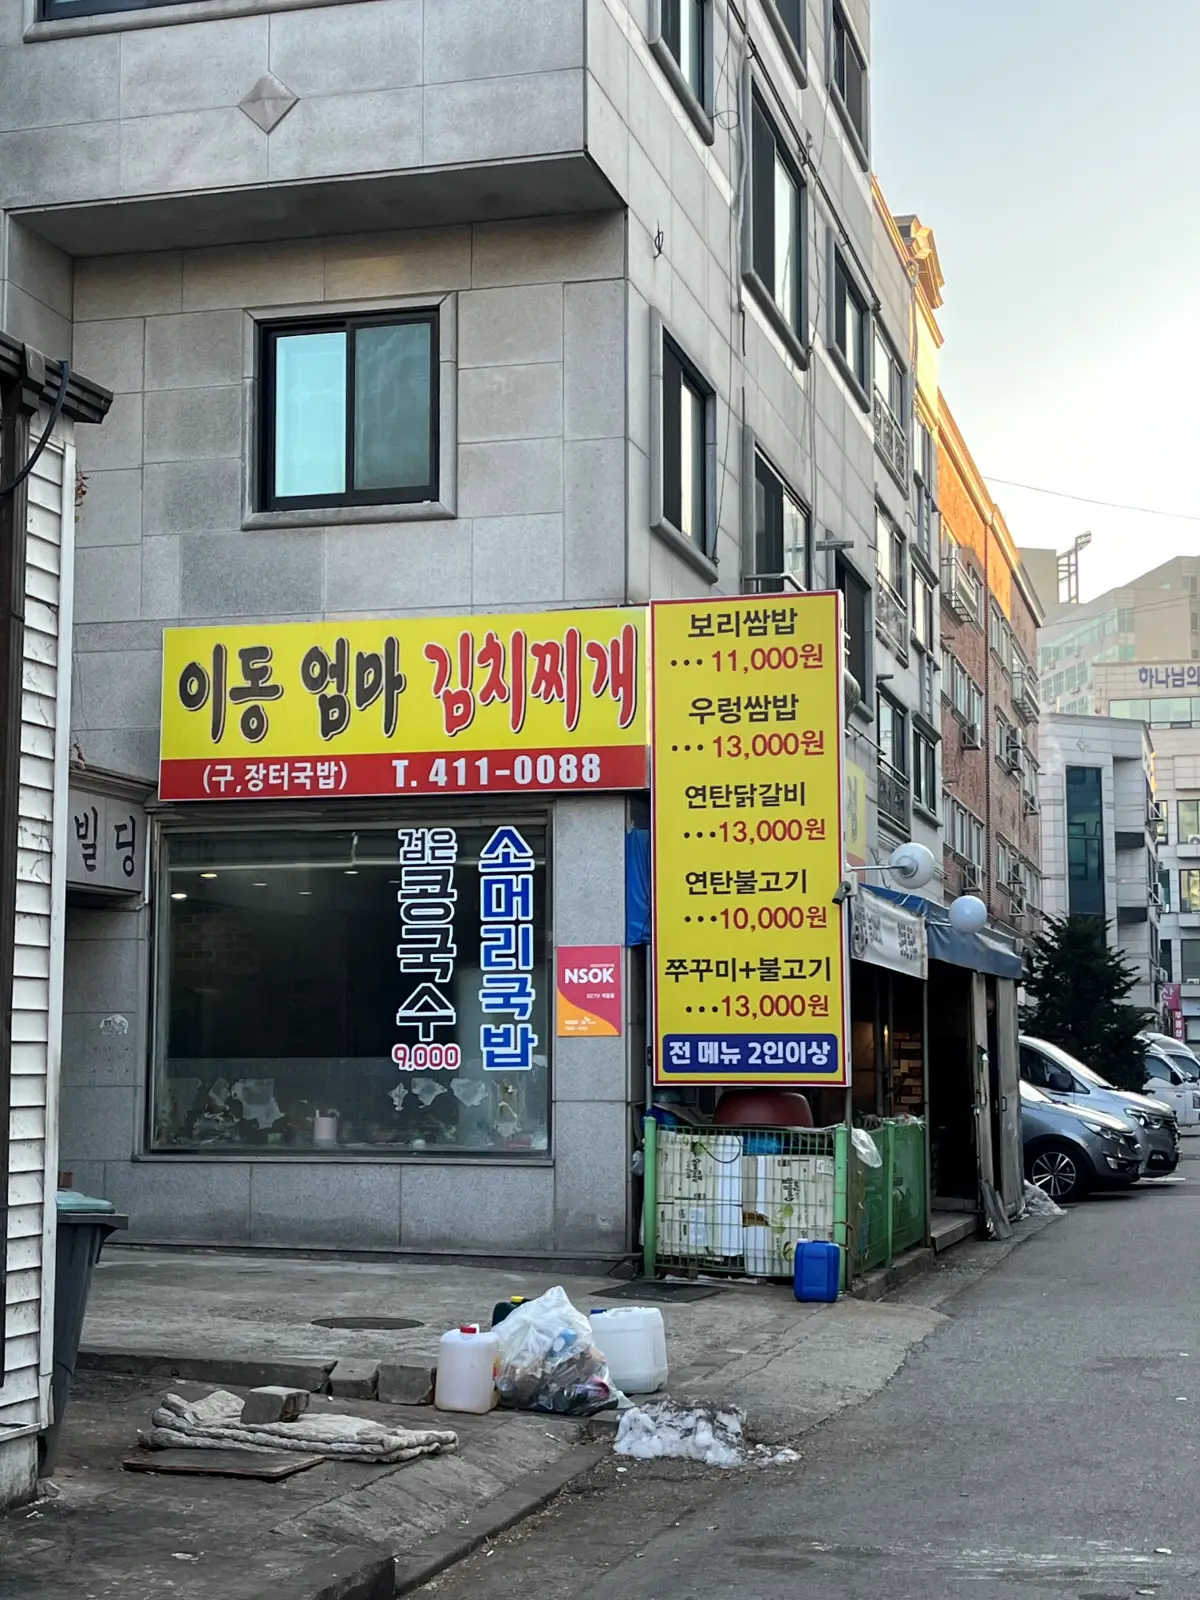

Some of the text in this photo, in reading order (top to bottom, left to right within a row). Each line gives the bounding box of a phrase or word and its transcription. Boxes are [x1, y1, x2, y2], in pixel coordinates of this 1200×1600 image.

[688, 608, 798, 638] 보리쌈밥
[712, 643, 824, 675] 11,000원
[179, 622, 638, 743] 이동 엄마 김치찌개
[1138, 665, 1200, 689] 하나님의
[688, 693, 799, 725] 우렁쌈밥
[712, 730, 825, 760] 13,000원
[203, 761, 347, 794] (구,장터국밥)
[428, 753, 601, 787] 411-0088
[684, 781, 806, 809] 연탄닭갈비
[719, 818, 826, 845] 13,000원
[684, 869, 808, 896] 연탄불고기
[720, 906, 828, 932] 10,000원
[478, 826, 538, 1071] 소머리국밥
[564, 967, 615, 984] NSOK
[664, 957, 831, 983] 쭈꾸미+불고기
[721, 994, 829, 1020] 13,000원
[392, 1043, 461, 1071] 9,000
[669, 1040, 831, 1066] 전 메뉴 2인이상
